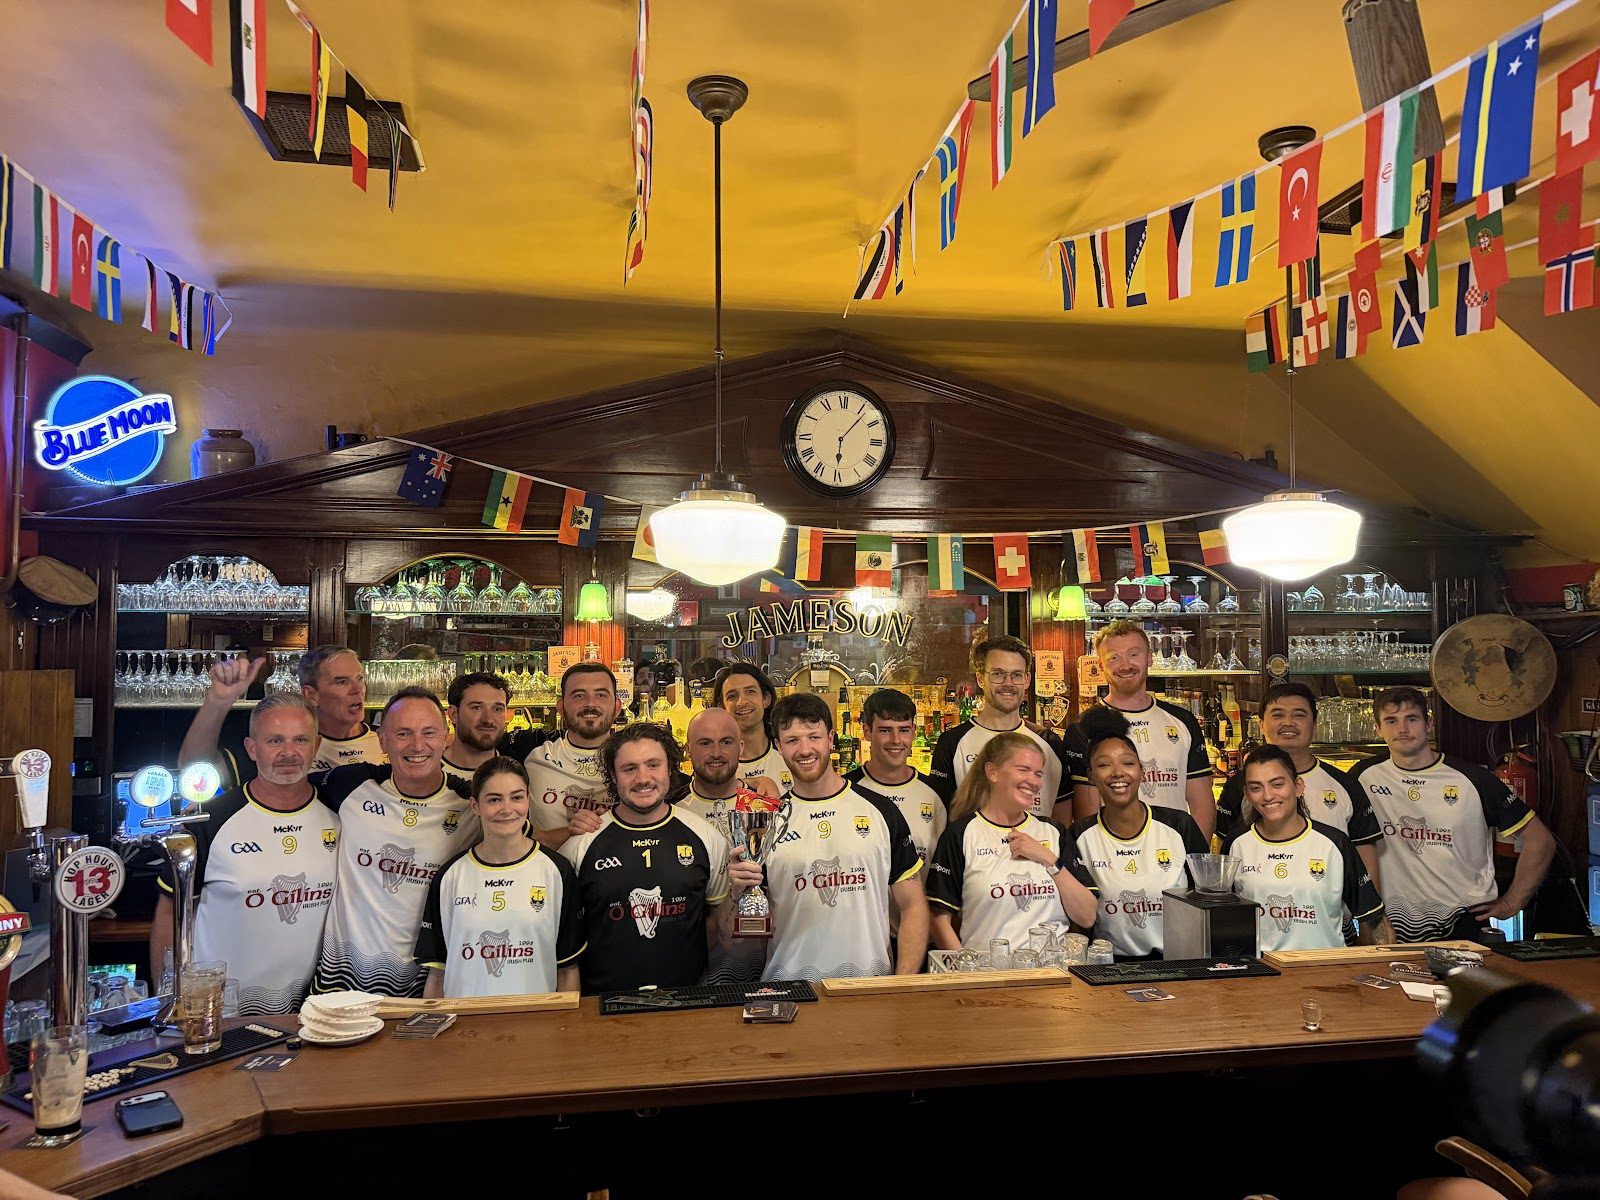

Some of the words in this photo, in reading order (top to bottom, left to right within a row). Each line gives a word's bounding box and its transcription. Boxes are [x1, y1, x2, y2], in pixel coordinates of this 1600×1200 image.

[42, 423, 108, 466] BLUE
[106, 402, 172, 440] MOON
[870, 438, 882, 446] III
[721, 599, 914, 648] JAMESON
[1133, 727, 1149, 743] 11
[574, 761, 598, 776] 20
[1407, 786, 1420, 801] 6
[403, 808, 418, 827] 8
[817, 820, 832, 839] 9
[282, 836, 297, 854] 9
[641, 849, 651, 868] 1
[1124, 858, 1137, 874] 4
[63, 861, 81, 882] HOP
[85, 854, 117, 875] HOUSE
[1274, 863, 1288, 879] 6
[72, 867, 111, 896] 13
[72, 891, 109, 906] LAGER
[491, 891, 506, 911] 5
